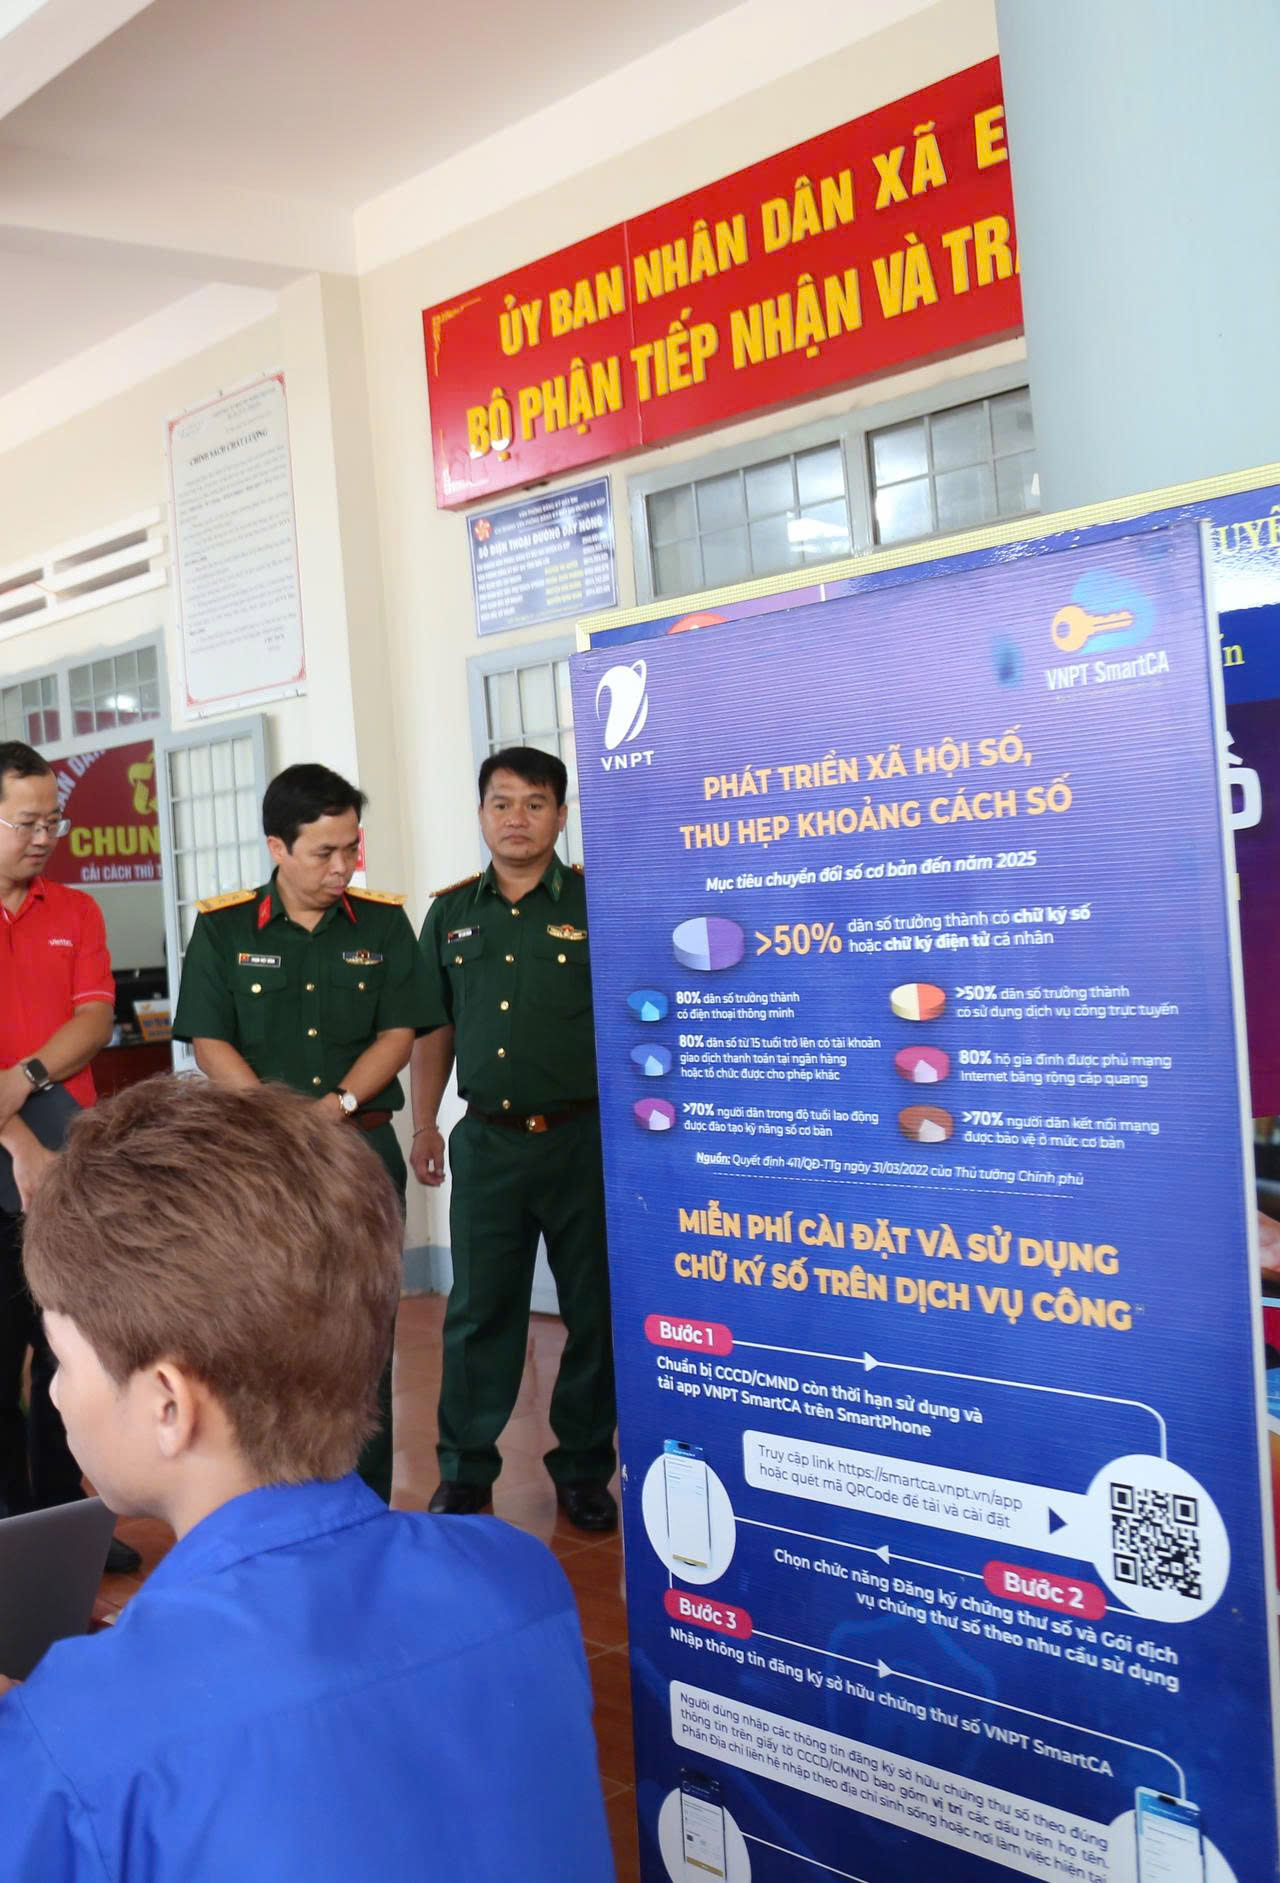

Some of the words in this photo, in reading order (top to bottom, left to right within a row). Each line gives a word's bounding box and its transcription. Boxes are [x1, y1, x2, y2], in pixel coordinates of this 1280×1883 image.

[498, 295, 542, 357] ỦY
[550, 265, 625, 336] BAN
[633, 214, 749, 304] NHÂN
[761, 175, 855, 252] DÂN
[872, 120, 948, 210] XÃ
[466, 388, 512, 462] BỘ
[518, 356, 624, 435] PHẬN
[629, 307, 719, 402] TIẾP
[729, 268, 862, 360] NHẬN
[872, 233, 938, 320] VÀ
[941, 214, 1020, 296] TR
[1046, 663, 1090, 691] VNPT
[1094, 650, 1170, 684] SmartCA
[600, 750, 655, 772] VNPT
[703, 764, 771, 800] PHÁT
[776, 749, 859, 790] TRIỂN
[865, 743, 907, 780] XÃ
[914, 736, 970, 777] HỘI
[977, 724, 1032, 766] SỐ,
[679, 821, 730, 848] THU
[737, 815, 790, 848] HẸP
[796, 795, 921, 837] KHOẢNG
[929, 787, 1017, 824] CÁCH
[1026, 772, 1072, 815] SỐ
[705, 877, 734, 893] Mục
[736, 873, 762, 888] tiêu
[764, 867, 816, 888] chuyển
[818, 864, 842, 882] đổi
[844, 862, 864, 880] số
[864, 863, 884, 878] cơ
[885, 859, 917, 877] bản
[919, 855, 951, 874] đến
[954, 854, 993, 871] năm
[995, 847, 1037, 868] 2025
[756, 922, 842, 957] >50%
[847, 918, 873, 932] dân
[874, 914, 892, 931] số
[893, 913, 941, 931] trưởng
[943, 910, 988, 927] thành
[990, 909, 1010, 924] có
[1011, 907, 1044, 923] chữ
[1045, 905, 1067, 924] ký
[1068, 902, 1091, 920] số
[848, 938, 881, 954] hoặc
[883, 935, 912, 951] chữ
[913, 934, 932, 952] ký
[934, 933, 969, 951] điện
[970, 930, 990, 947] tử
[993, 931, 1010, 946] cá
[1013, 929, 1054, 945] nhân
[679, 1199, 741, 1238] MIỄN
[747, 1210, 792, 1243] PHÍ
[798, 1213, 845, 1248] CÀI
[850, 1218, 911, 1259] ĐẶT
[915, 1223, 962, 1259] VÀ
[967, 1225, 1012, 1264] SỬ
[1019, 1237, 1119, 1276] DỤNG
[674, 1249, 728, 1281] CHỮ
[732, 1254, 766, 1286] KÝ
[771, 1256, 808, 1291] SỐ
[813, 1264, 888, 1301] TRÊN
[895, 1276, 970, 1313] DỊCH
[975, 1285, 1024, 1324] VỤ
[1031, 1286, 1132, 1331] CÔNG
[659, 1321, 703, 1345] Bước
[705, 1328, 714, 1346] 1
[656, 1355, 697, 1374] Chuẩn
[699, 1362, 712, 1380] bị
[714, 1365, 799, 1391] CCCD/CMND
[801, 1380, 828, 1397] còn
[830, 1385, 860, 1402] thời
[863, 1389, 892, 1409] hạn
[895, 1394, 915, 1412] sử
[917, 1399, 960, 1423] dụng
[962, 1407, 983, 1423] và
[657, 1375, 673, 1390] tải
[676, 1381, 700, 1397] app
[702, 1383, 738, 1401] VNPT
[741, 1390, 801, 1413] SmartCA
[803, 1402, 834, 1419] trên
[836, 1407, 931, 1436] SmartPhone
[757, 1444, 784, 1463] Truy
[812, 1455, 834, 1470] link
[838, 1460, 1021, 1509] https://smartca.vnpt.vn/app
[759, 1462, 788, 1480] hoặc
[791, 1472, 819, 1487] quét
[823, 1478, 842, 1491] mã
[846, 1481, 898, 1503] QRCode
[922, 1497, 939, 1512] tải
[943, 1503, 958, 1516] và
[963, 1508, 982, 1521] cài
[986, 1511, 1010, 1528] đặt
[679, 1597, 722, 1625] Bước
[725, 1611, 737, 1630] 3
[774, 1548, 810, 1569] Chọn
[813, 1559, 848, 1578] chức
[851, 1569, 889, 1592] năng
[892, 1578, 934, 1604] Đăng
[938, 1588, 957, 1609] ký
[960, 1596, 1013, 1624] chứng
[1016, 1610, 1048, 1630] thư
[1051, 1619, 1072, 1636] số
[1075, 1626, 1096, 1643] và
[1101, 1631, 1132, 1652] Gói
[1135, 1640, 1178, 1664] dịch
[1003, 1571, 1064, 1603] Bước
[1068, 1587, 1085, 1609] 2
[856, 1592, 874, 1609] vụ
[878, 1597, 926, 1624] chứng
[929, 1610, 958, 1629] thư
[961, 1619, 981, 1634] số
[983, 1624, 1023, 1646] theo
[1026, 1636, 1061, 1657] nhu
[1064, 1646, 1097, 1667] cầu
[1101, 1655, 1124, 1674] sử
[1128, 1662, 1179, 1692] dụng
